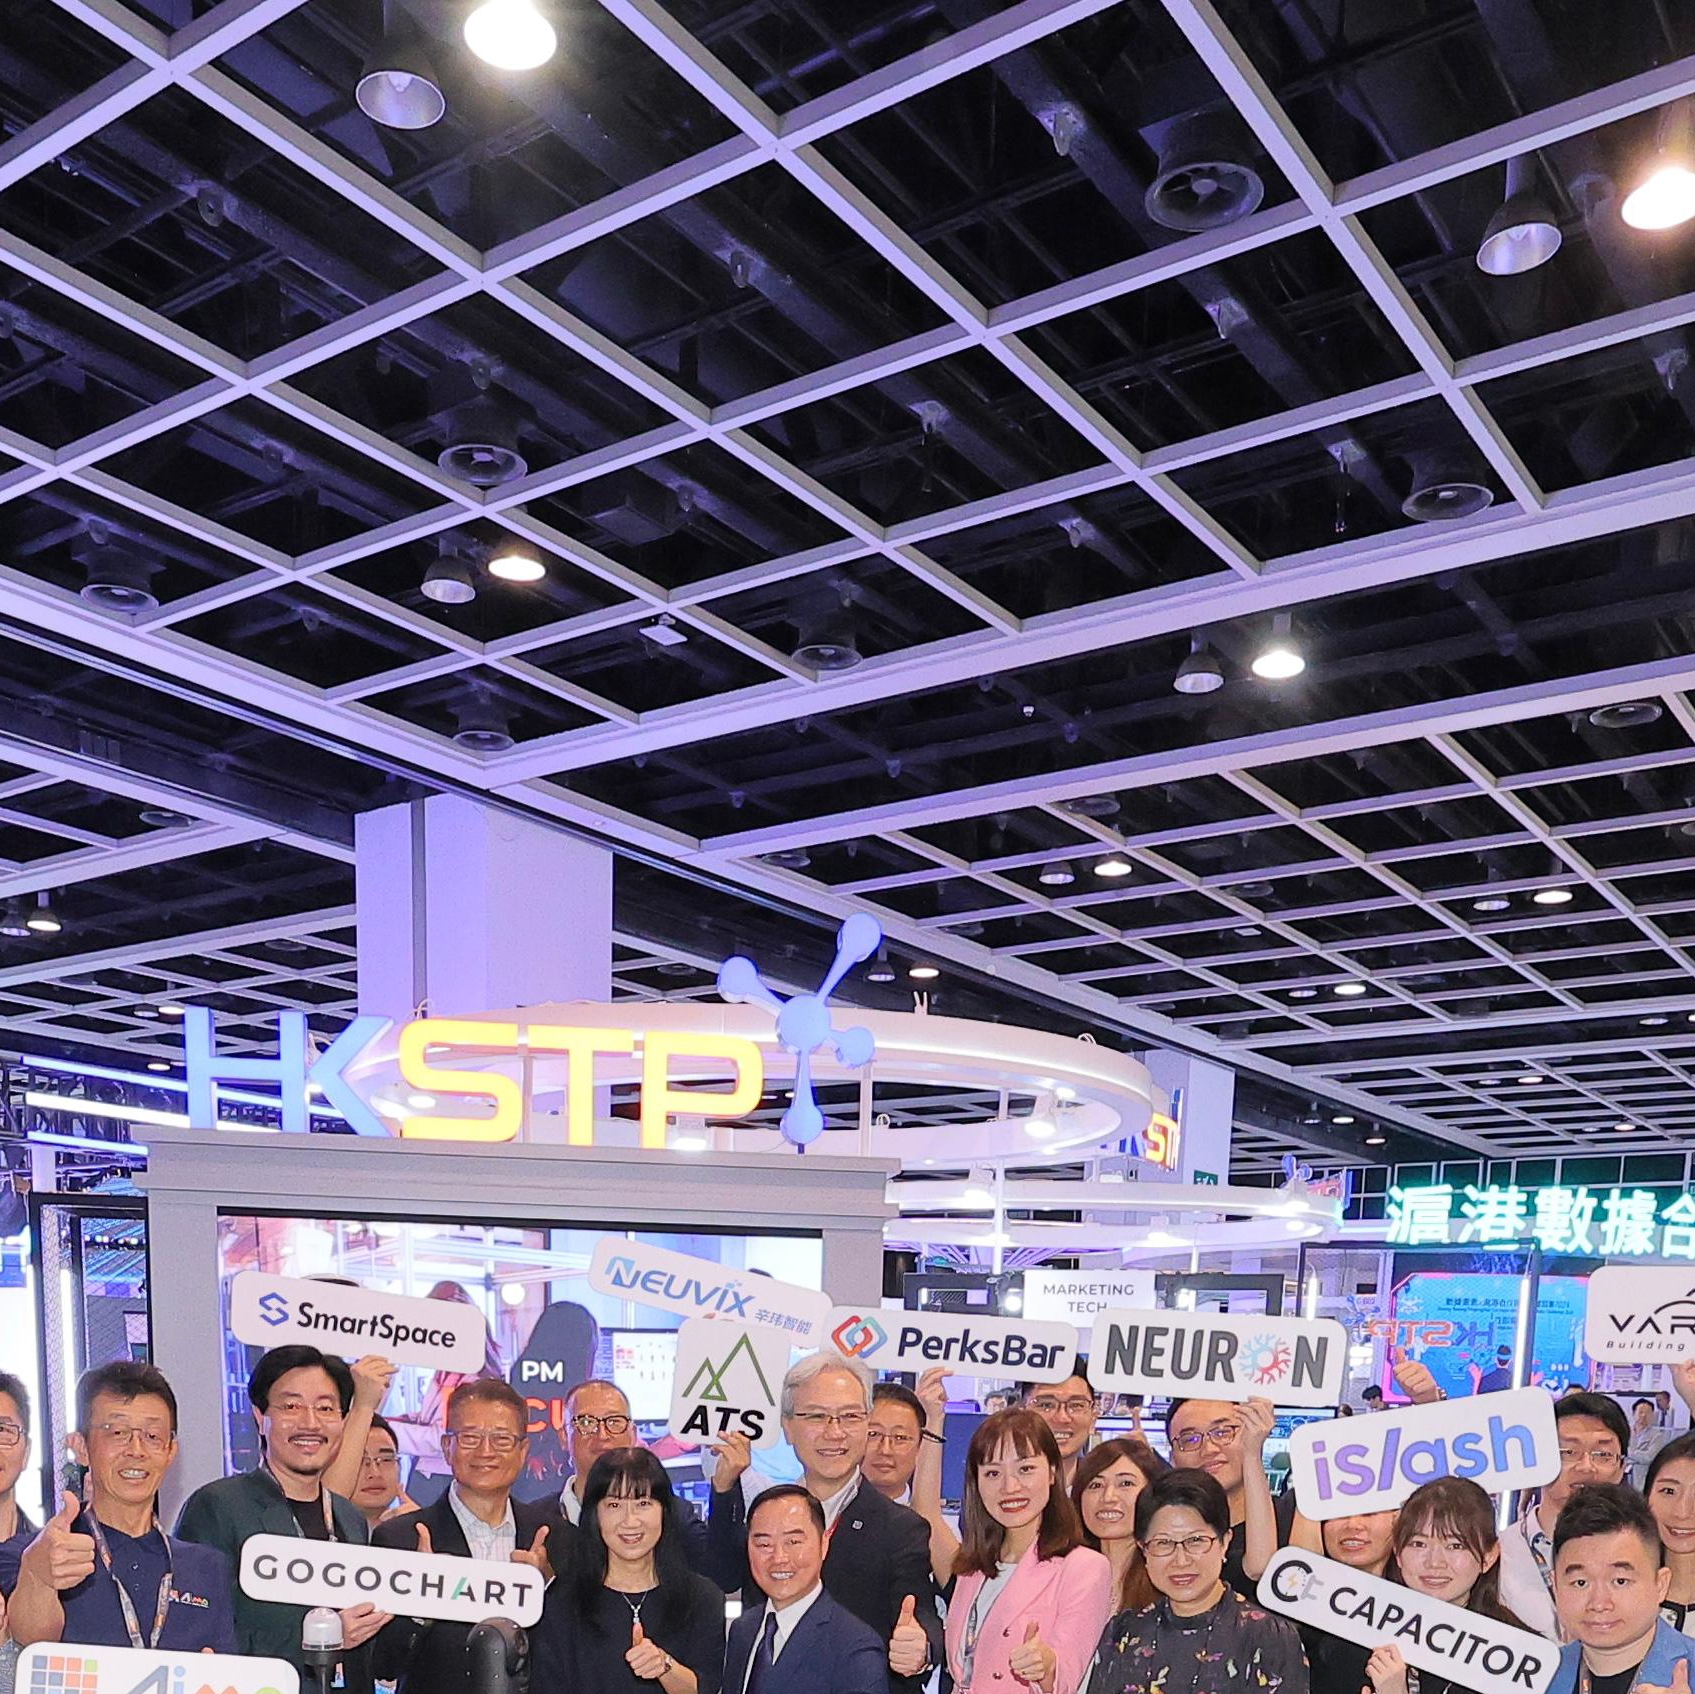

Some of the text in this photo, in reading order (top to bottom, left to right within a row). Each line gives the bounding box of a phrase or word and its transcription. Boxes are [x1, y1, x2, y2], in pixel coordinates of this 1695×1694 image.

[184, 1005, 764, 1150] HKSTP
[1042, 1283, 1135, 1297] MARKETING
[1067, 1299, 1109, 1313] TECH
[296, 1301, 457, 1349] SmartSpace
[897, 1326, 1066, 1370] PerksBar
[1606, 1340, 1685, 1352] Building
[521, 1361, 564, 1383] PM
[680, 1404, 766, 1441] ATS
[253, 1554, 533, 1607] GOGOCHART
[1329, 1586, 1543, 1690] CAPACITOR
